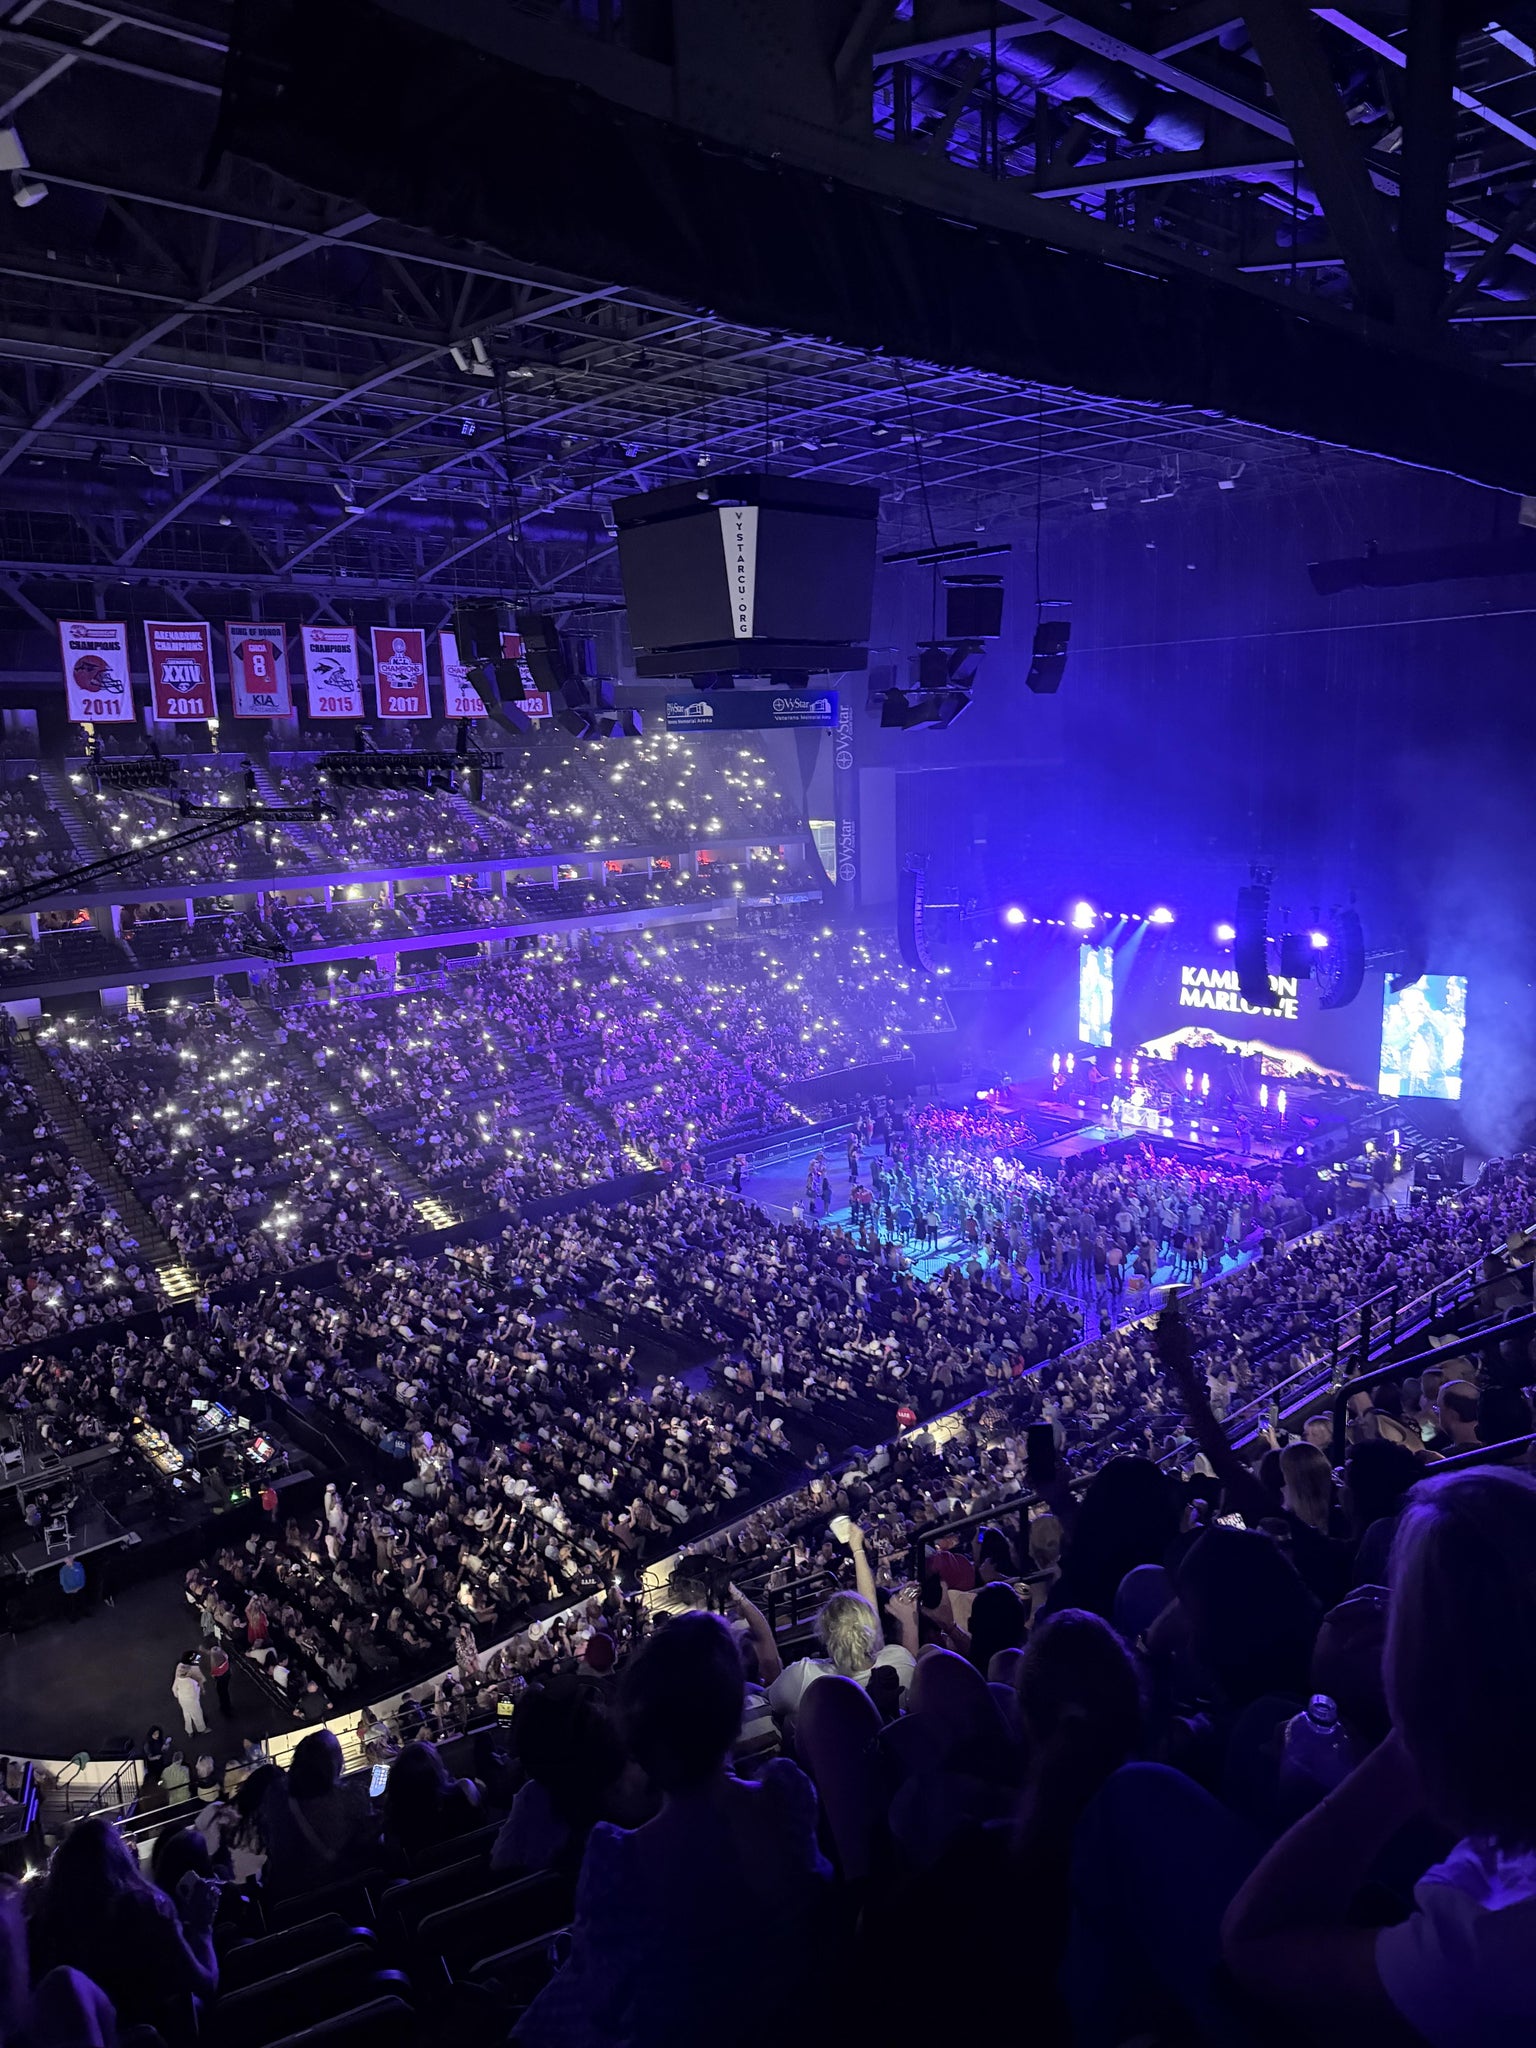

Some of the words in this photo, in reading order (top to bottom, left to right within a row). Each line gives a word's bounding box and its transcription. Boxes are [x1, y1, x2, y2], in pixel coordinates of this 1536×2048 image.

[69, 640, 121, 651] CHAMPIONS
[154, 641, 204, 651] CHAMPIONS
[310, 643, 352, 653] CHAMPIONS
[252, 654, 267, 677] 8
[381, 665, 420, 673] CHAMPIONS
[162, 665, 201, 682] XXIV
[82, 699, 121, 715] 2011
[167, 698, 205, 714] 2011
[252, 695, 278, 707] KIA
[319, 697, 353, 712] 2015
[389, 696, 419, 712] 2017
[455, 698, 484, 712] 2019
[784, 698, 809, 711] VyStar
[836, 705, 853, 751] VyStar
[839, 819, 856, 864] VyStar
